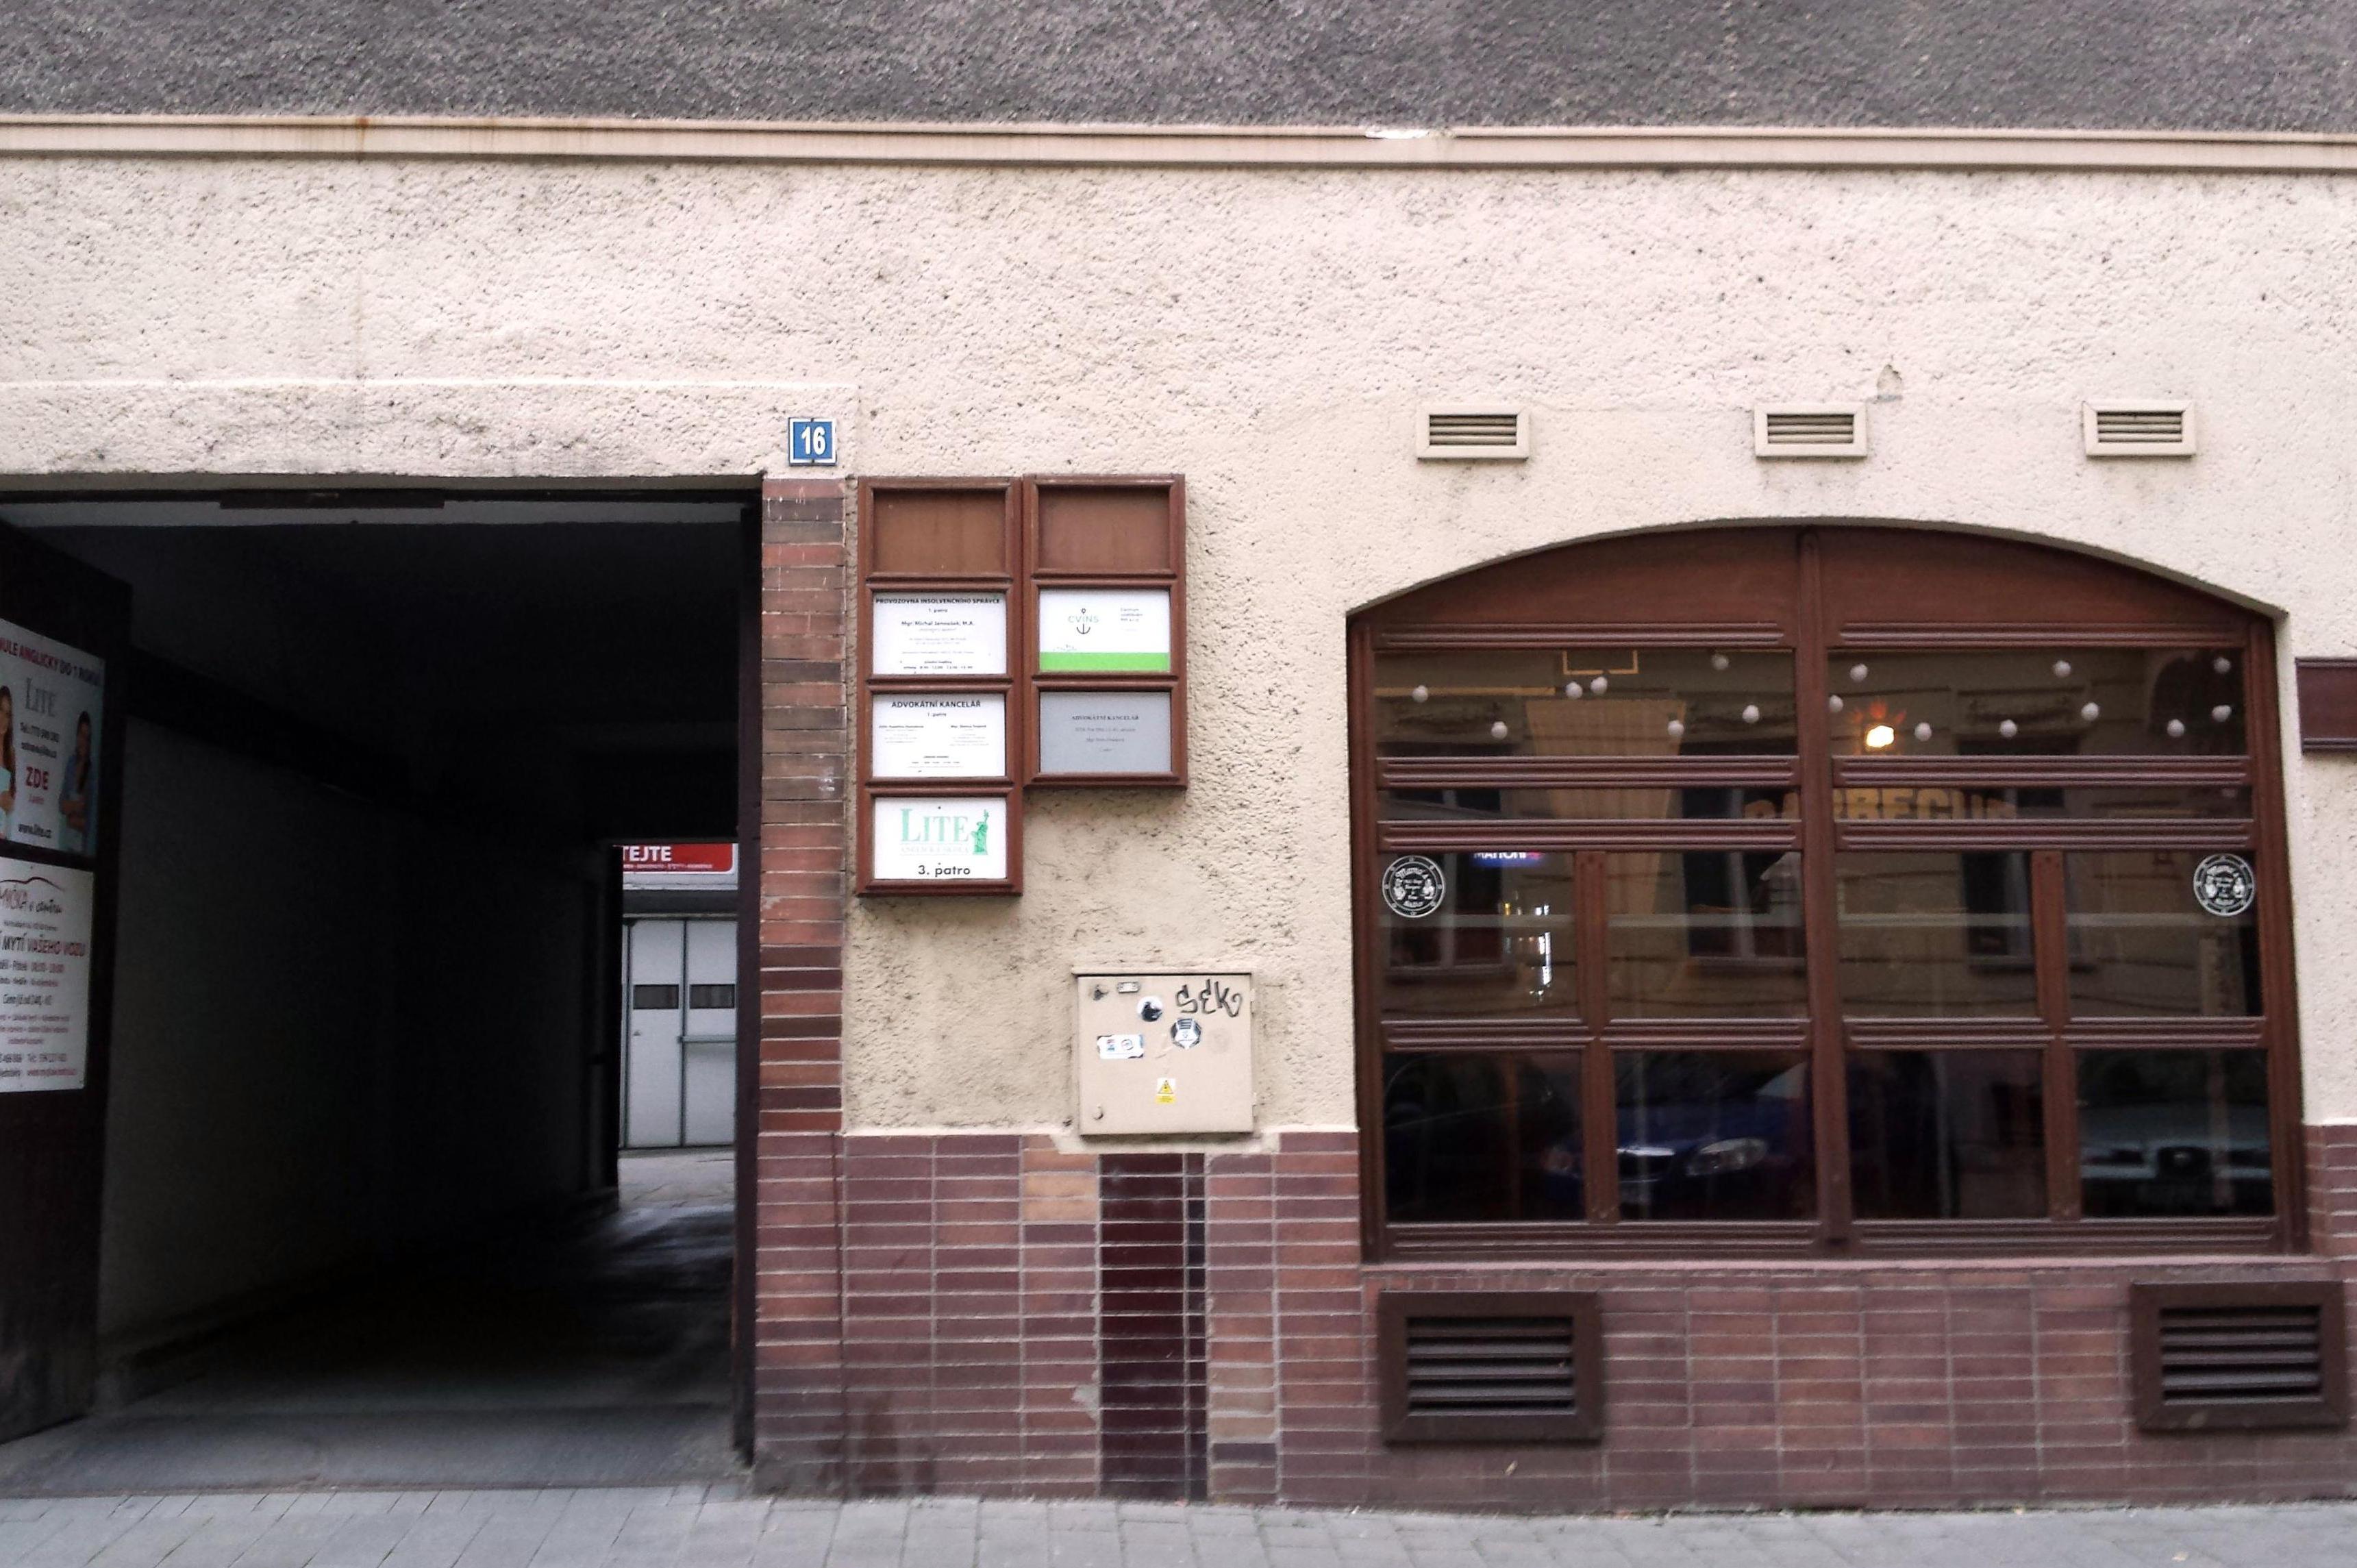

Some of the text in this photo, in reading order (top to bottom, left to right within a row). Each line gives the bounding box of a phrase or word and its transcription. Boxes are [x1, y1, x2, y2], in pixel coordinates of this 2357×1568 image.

[801, 426, 826, 456] 16
[891, 699, 982, 708] ADVOKÁTNÍ KANCELÁŘ
[900, 808, 969, 842] LITE
[918, 865, 971, 878] 3. patro
